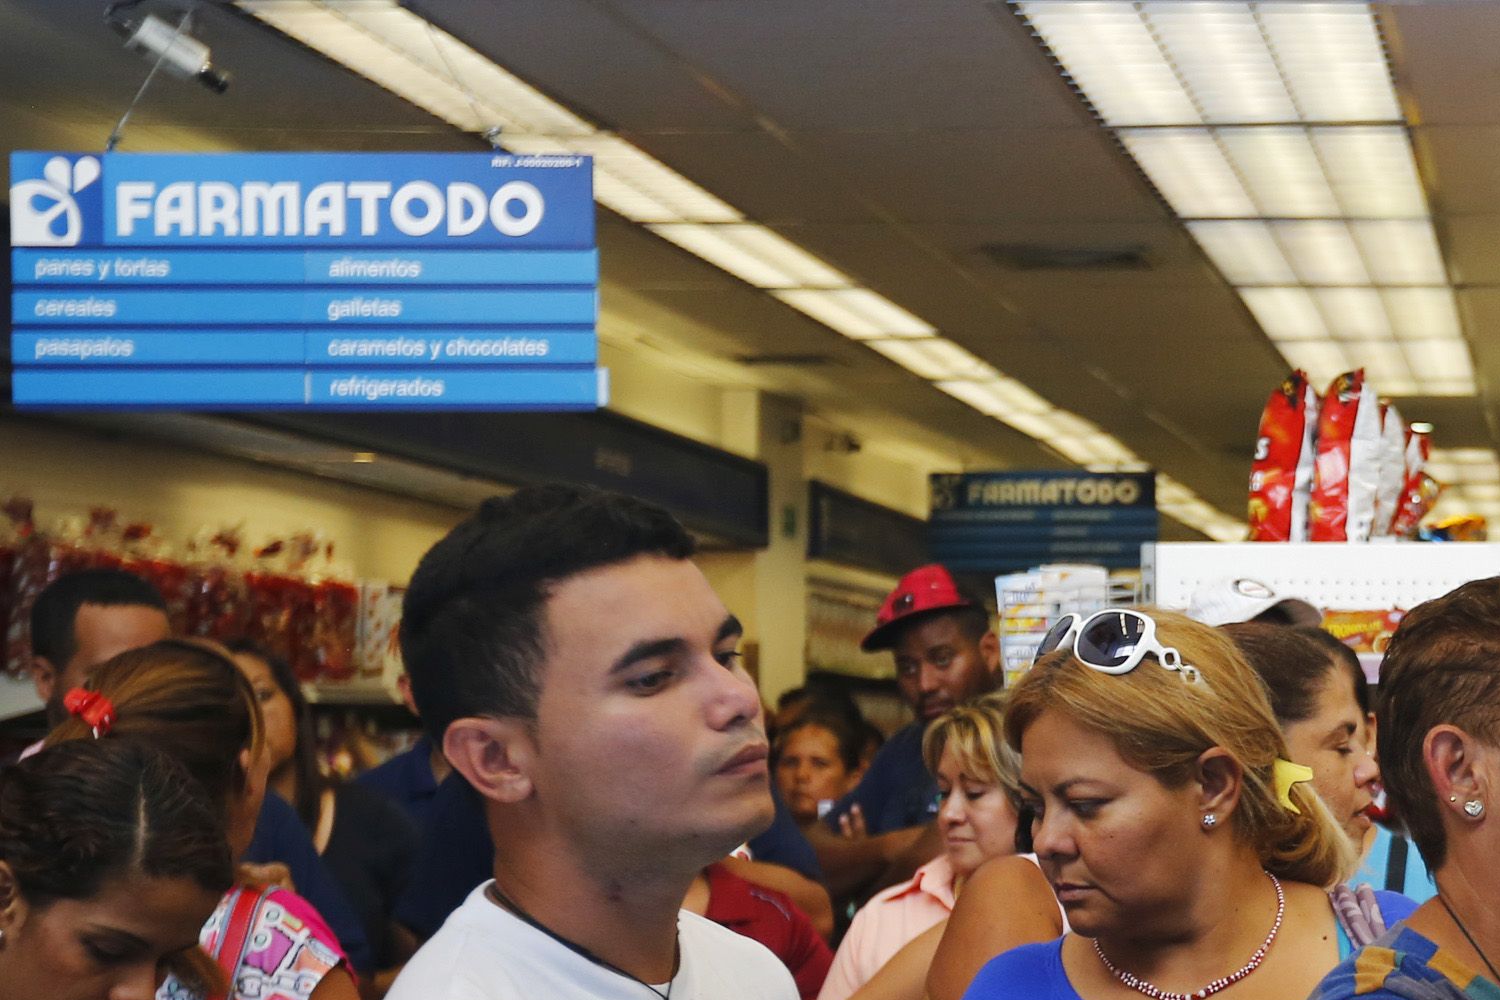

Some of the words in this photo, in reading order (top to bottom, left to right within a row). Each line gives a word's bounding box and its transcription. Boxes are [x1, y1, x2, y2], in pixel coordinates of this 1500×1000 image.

[116, 181, 545, 237] FARMATODO
[34, 258, 95, 280] panes
[97, 262, 110, 281] y
[114, 257, 171, 278] tortas
[328, 258, 422, 278] alimentos
[34, 297, 118, 318] cereales
[327, 297, 402, 321] galletas
[34, 337, 135, 360] pasapalos
[327, 337, 426, 357] caramelos
[429, 340, 443, 361] y
[445, 336, 549, 357] chocolates
[329, 376, 445, 400] refrigerados
[967, 478, 1140, 504] FARMATODO
